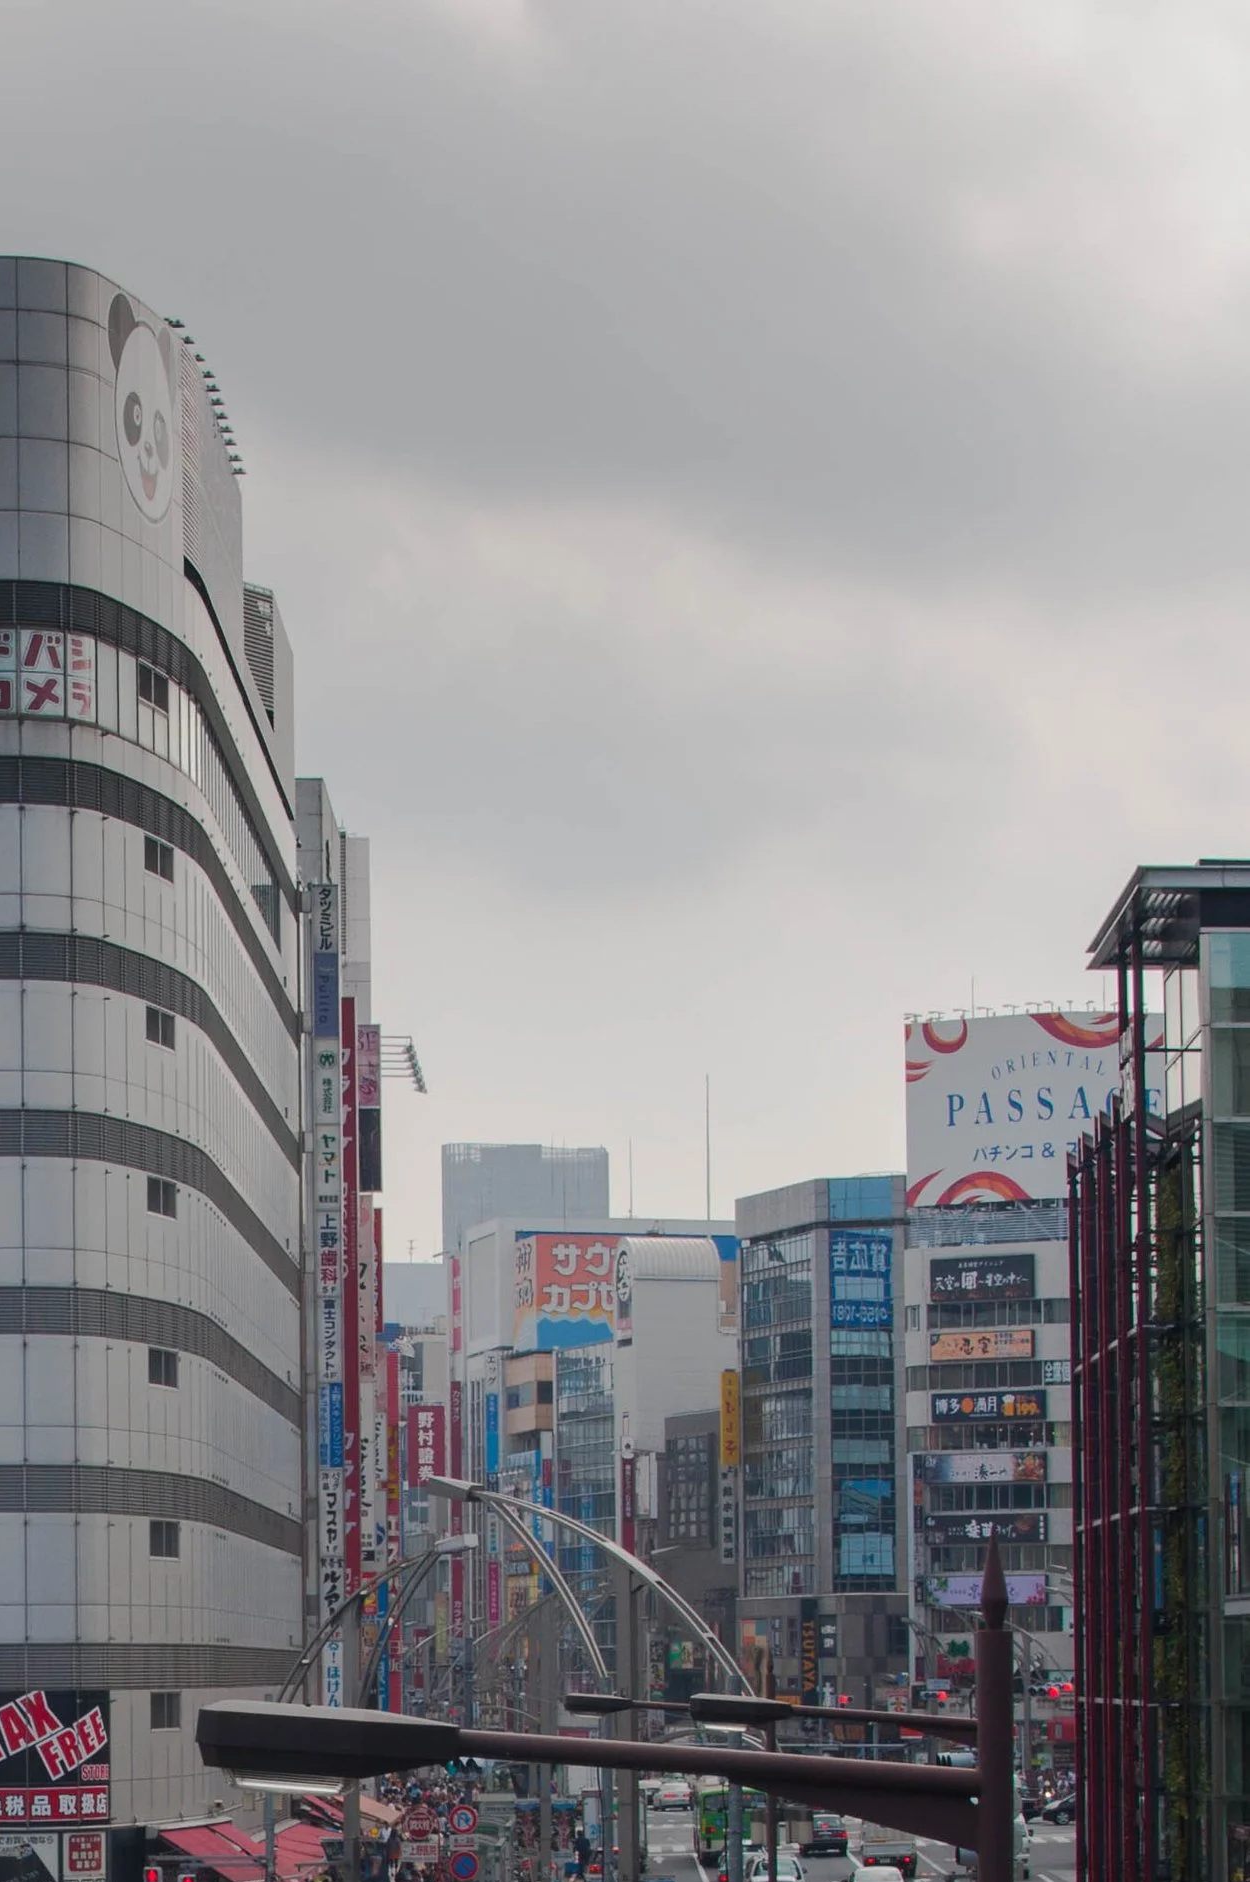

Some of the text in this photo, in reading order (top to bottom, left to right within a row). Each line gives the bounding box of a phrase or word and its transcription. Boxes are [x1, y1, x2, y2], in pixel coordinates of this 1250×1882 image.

[319, 888, 334, 951] タツミビル
[991, 1048, 1106, 1081] ORIENTAL
[321, 1134, 337, 1184] ヤマト
[973, 1142, 1035, 1163] パチンコ
[1041, 1142, 1056, 1159] &
[320, 1214, 338, 1285] 上野歯科
[550, 1242, 616, 1277] サウ
[323, 1299, 337, 1371] 富士コンタクト
[934, 1396, 961, 1416] 博多
[417, 1411, 435, 1482] 野村證券
[802, 1620, 816, 1692] TSUTAYA
[35, 1705, 108, 1782] FREE
